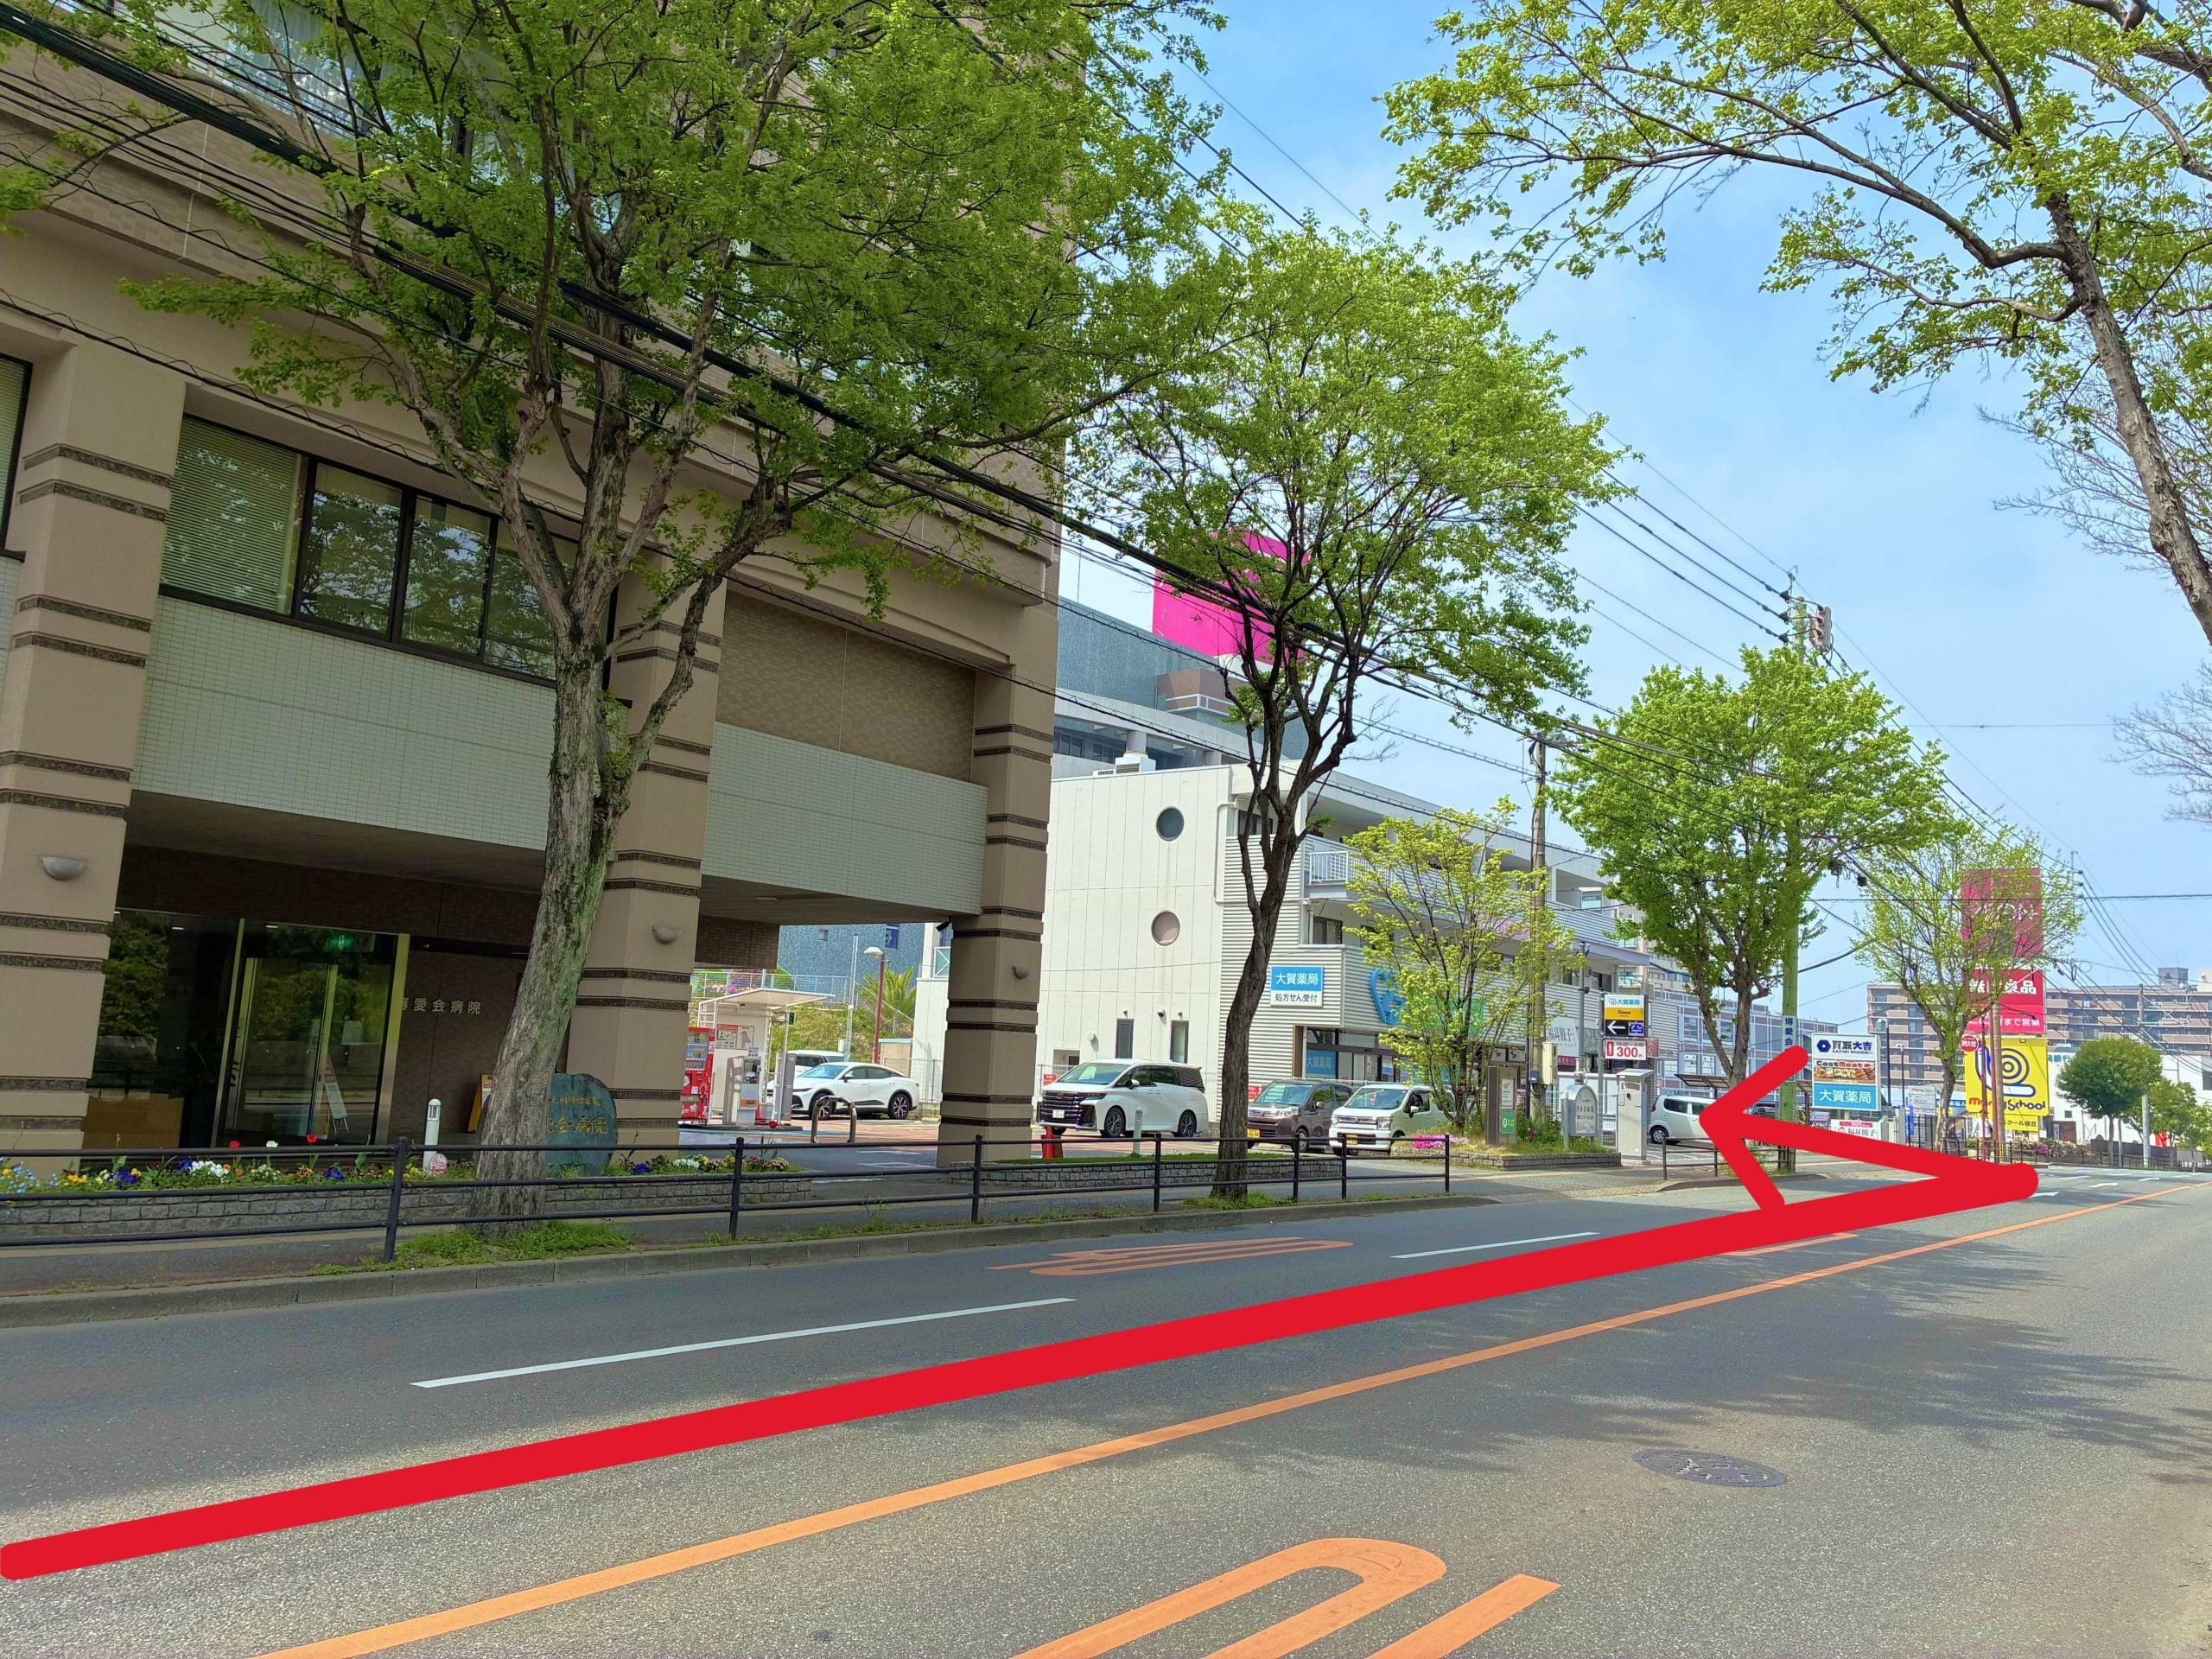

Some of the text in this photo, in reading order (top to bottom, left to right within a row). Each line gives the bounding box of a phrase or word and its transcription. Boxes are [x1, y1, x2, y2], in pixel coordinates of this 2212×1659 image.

[1275, 972, 1319, 985] 大賀薬局
[1274, 994, 1318, 1002] 処方せん受付
[1784, 1017, 1794, 1051] 博愛会
[1833, 1040, 1872, 1051] 買取大吉
[1819, 1089, 1872, 1103] 大賀薬局
